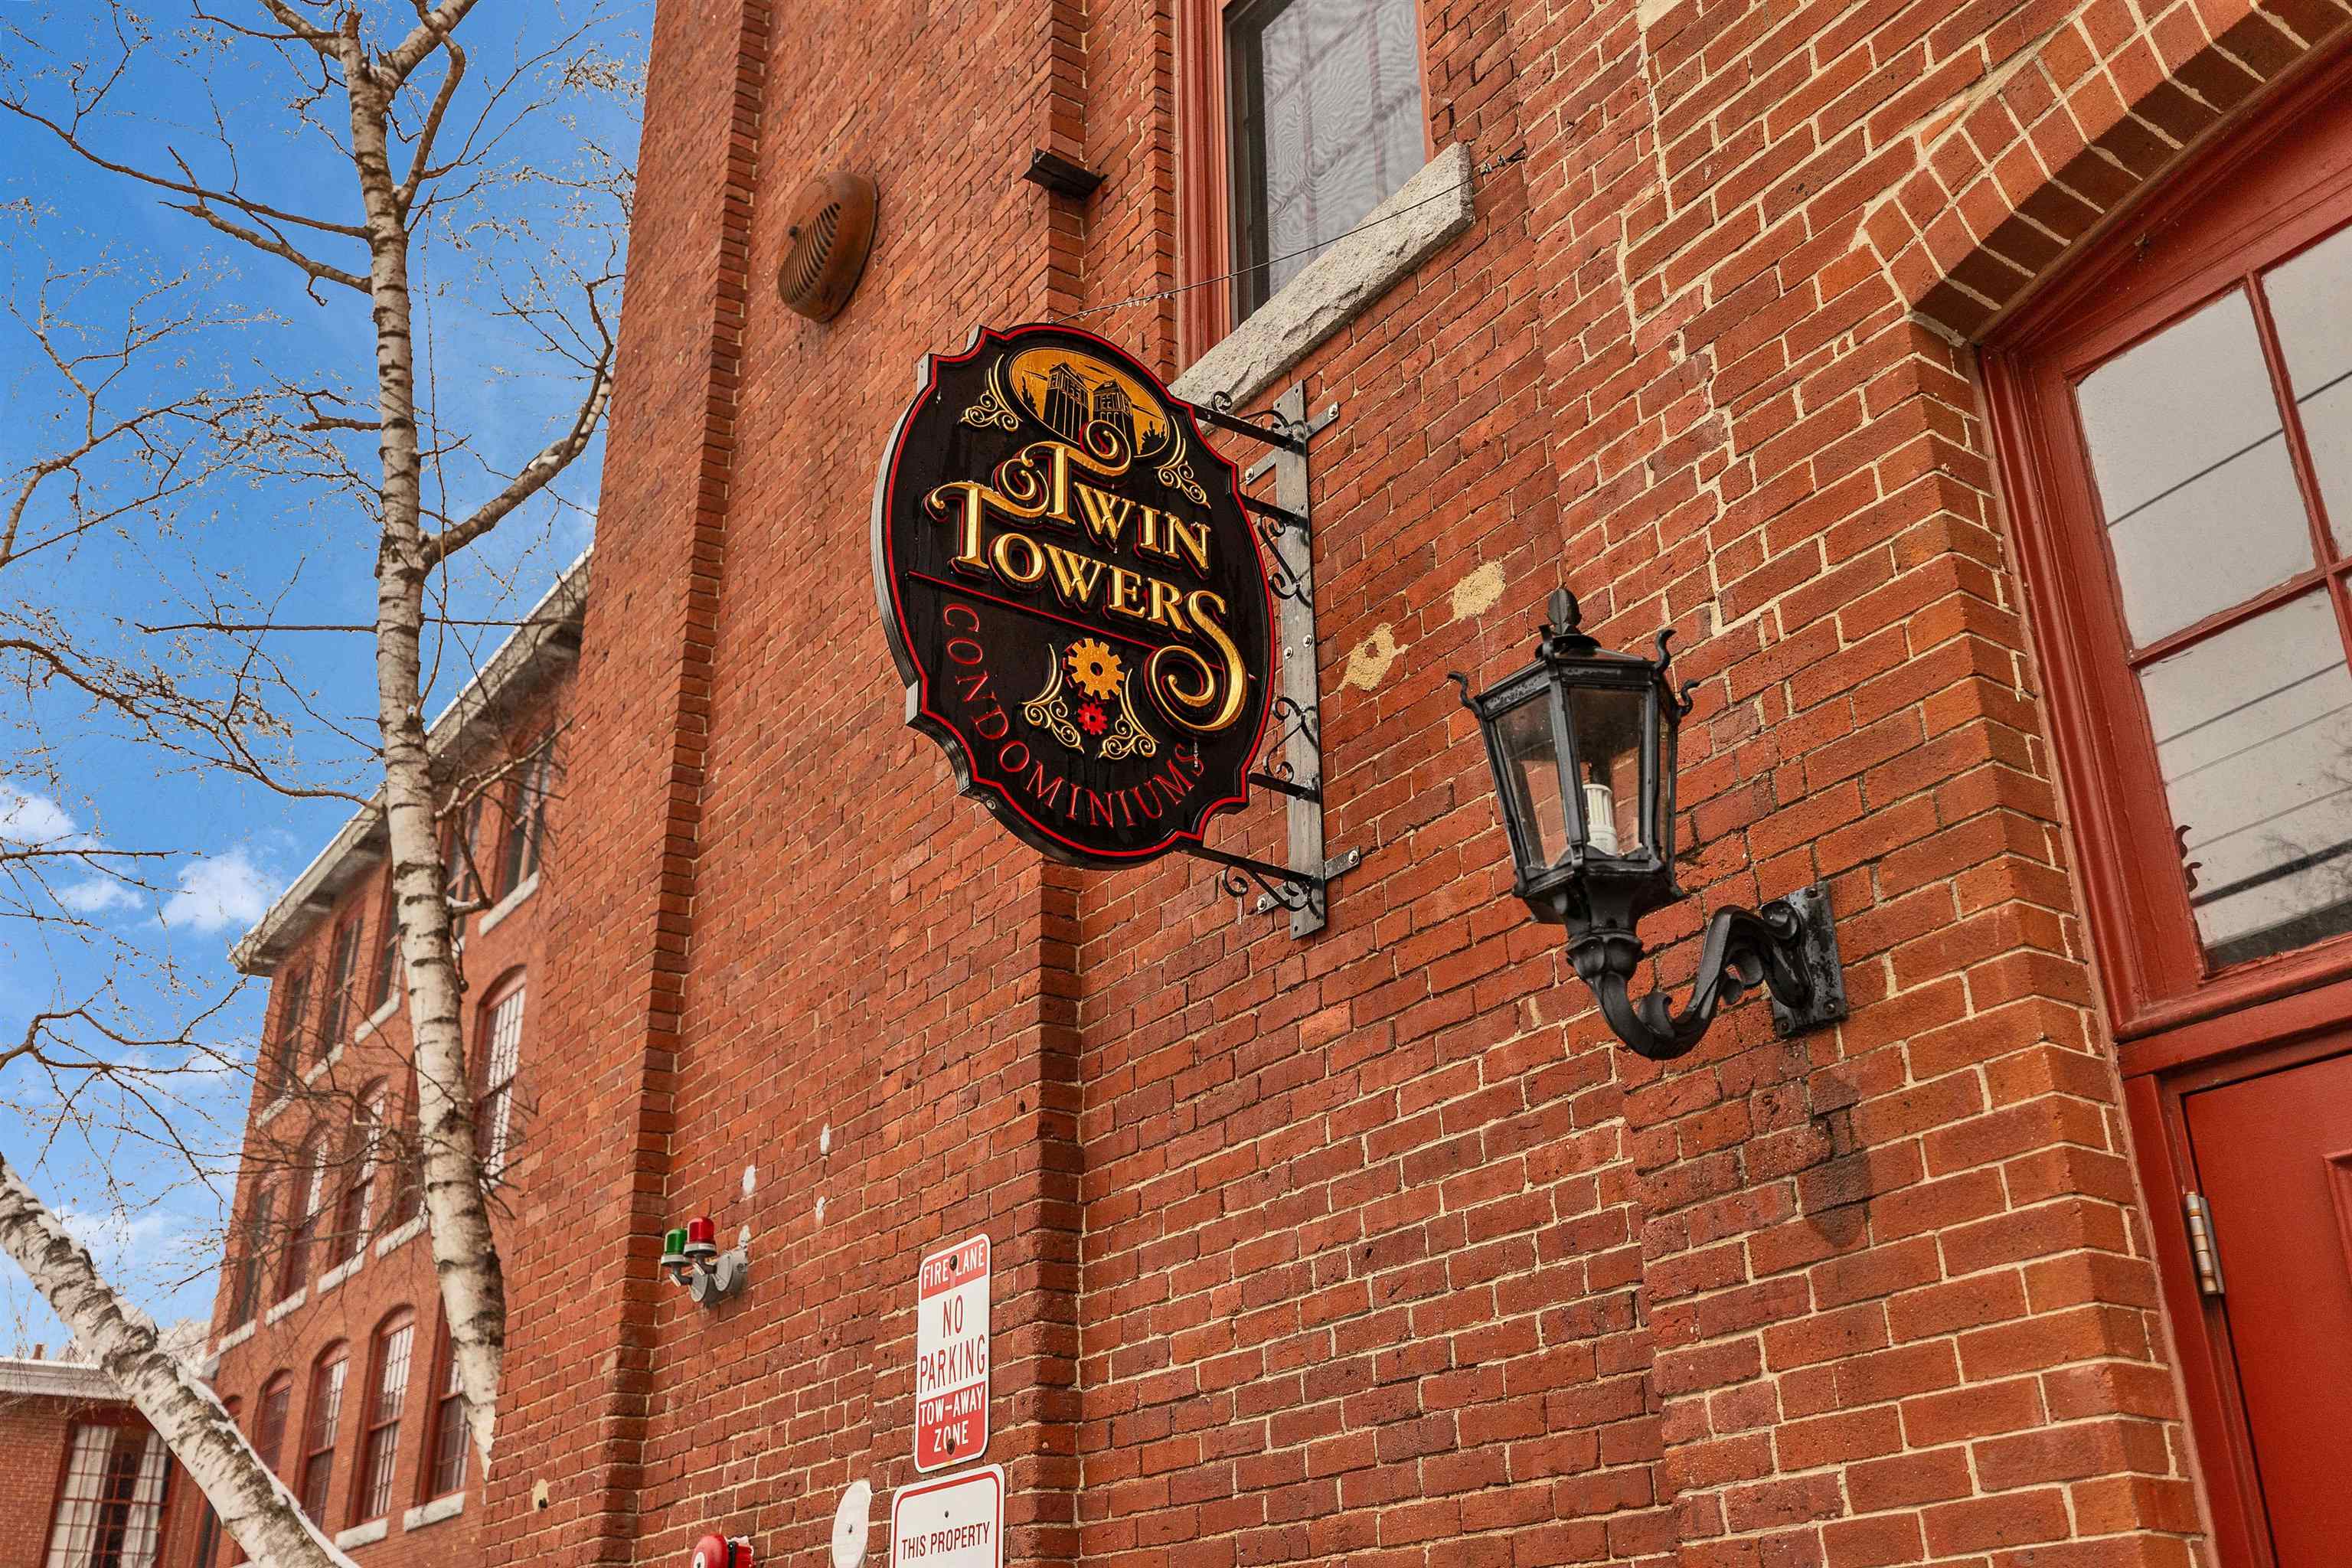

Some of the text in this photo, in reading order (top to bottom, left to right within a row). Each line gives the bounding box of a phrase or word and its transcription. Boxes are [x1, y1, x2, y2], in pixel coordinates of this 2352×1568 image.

[1022, 420, 1211, 570] TWIN
[932, 459, 1248, 731] TOWERS
[943, 603, 1205, 828] CONDOMINIUMS
[923, 1243, 985, 1289] FIRE LANE
[942, 1295, 963, 1338] NO
[920, 1334, 985, 1396] PARKING
[920, 1386, 985, 1427] TOW-AWAY
[933, 1420, 969, 1452] ZONE
[901, 1521, 990, 1560] THIS PROPERTY
